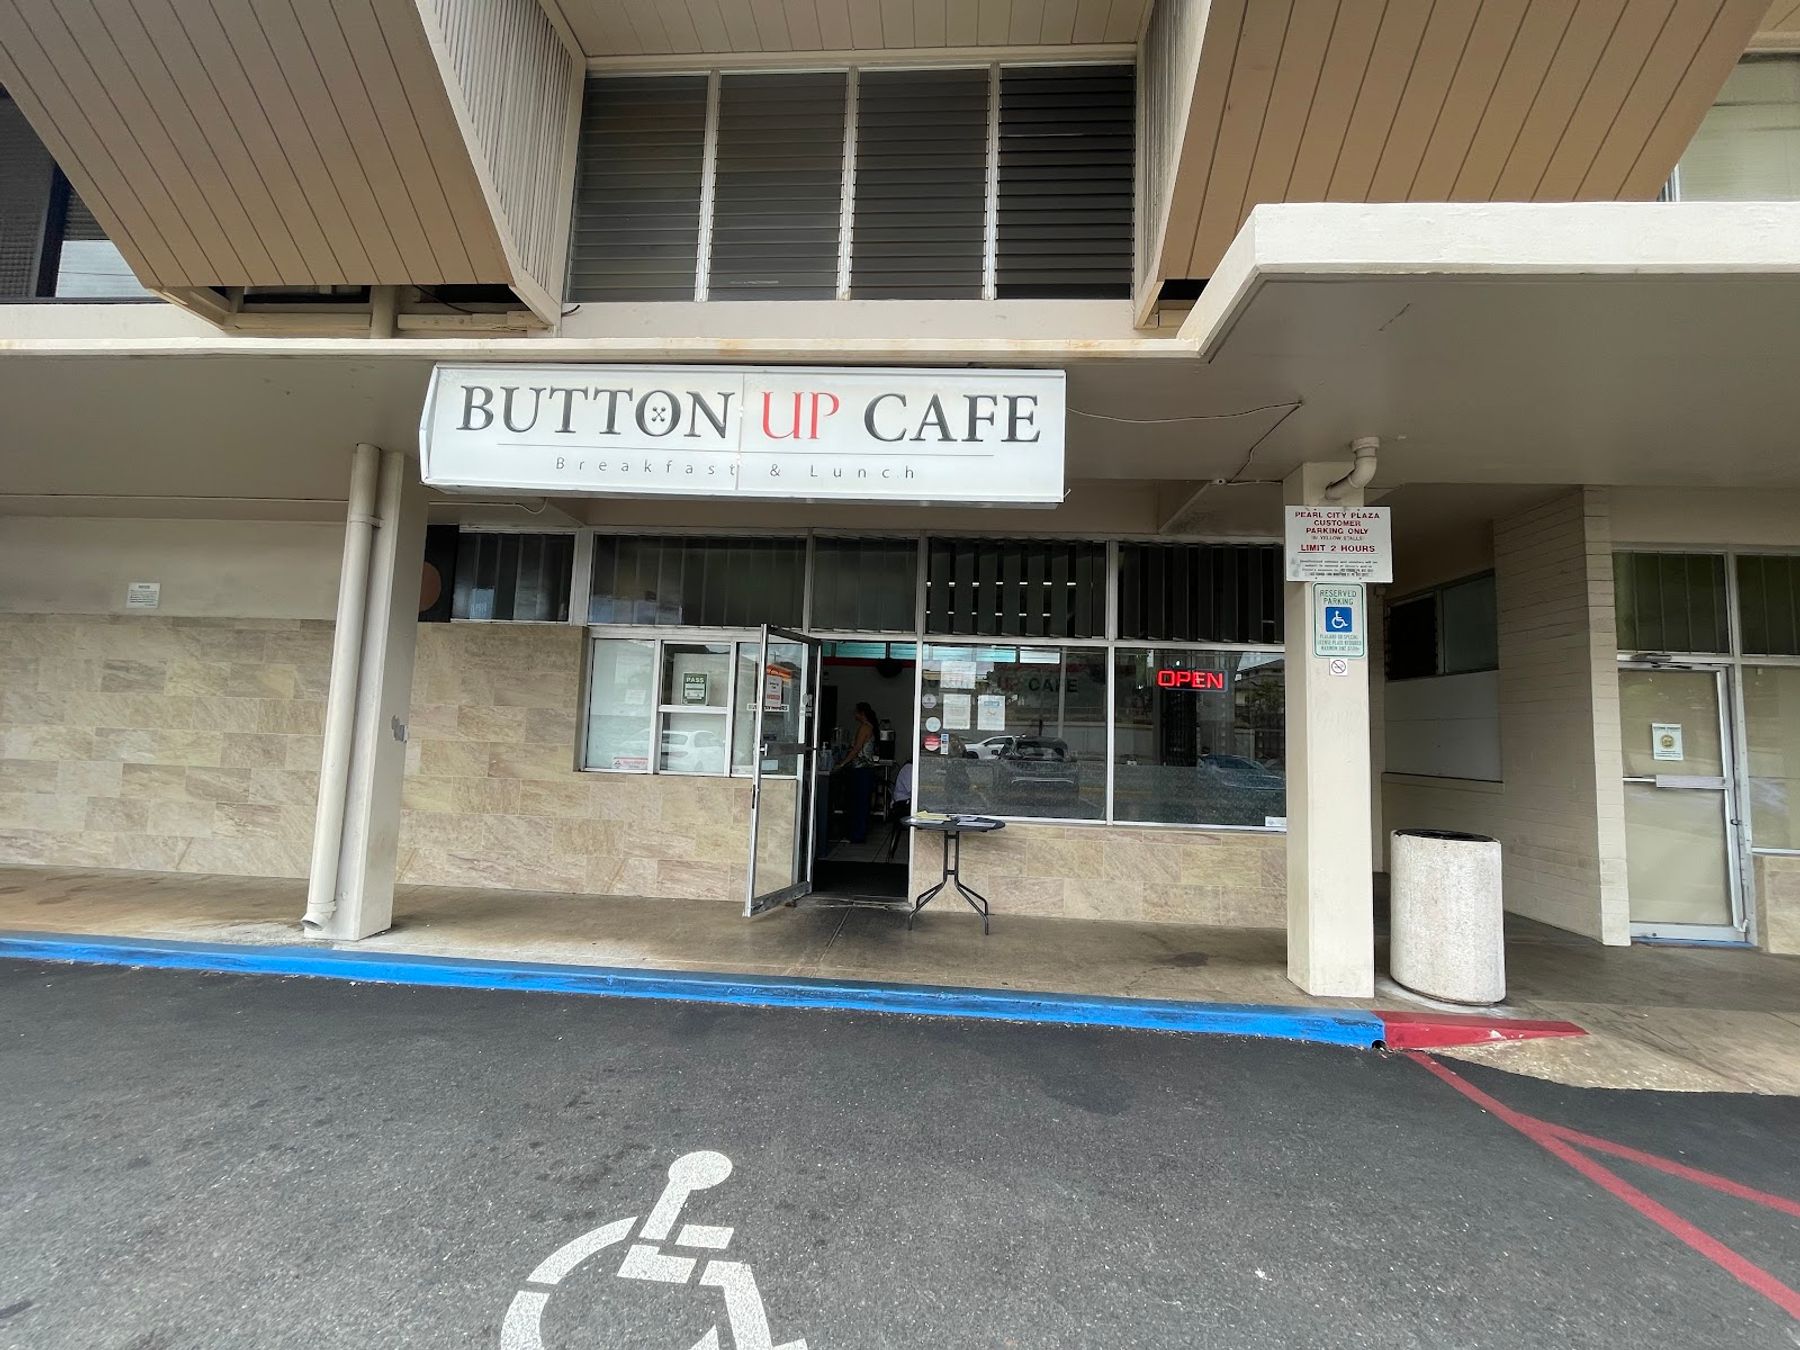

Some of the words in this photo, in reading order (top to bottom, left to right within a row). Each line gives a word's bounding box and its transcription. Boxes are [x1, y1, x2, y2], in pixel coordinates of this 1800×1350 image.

[456, 384, 736, 440] BUTTON
[761, 390, 840, 441] UP
[862, 392, 1041, 444] CAFE
[555, 456, 737, 478] Breakfast
[769, 464, 781, 477] &
[810, 465, 916, 480] Lunch
[1294, 511, 1323, 519] PEARL
[1326, 511, 1347, 519] CITY
[1313, 519, 1361, 527] CUSTOMER
[1305, 527, 1344, 535] PARKING
[1300, 544, 1326, 552] LIMIT
[1340, 545, 1376, 553] HOURS
[1319, 589, 1357, 598] RESERVED
[1323, 597, 1354, 606] PARKING
[1157, 669, 1224, 689] OPEN
